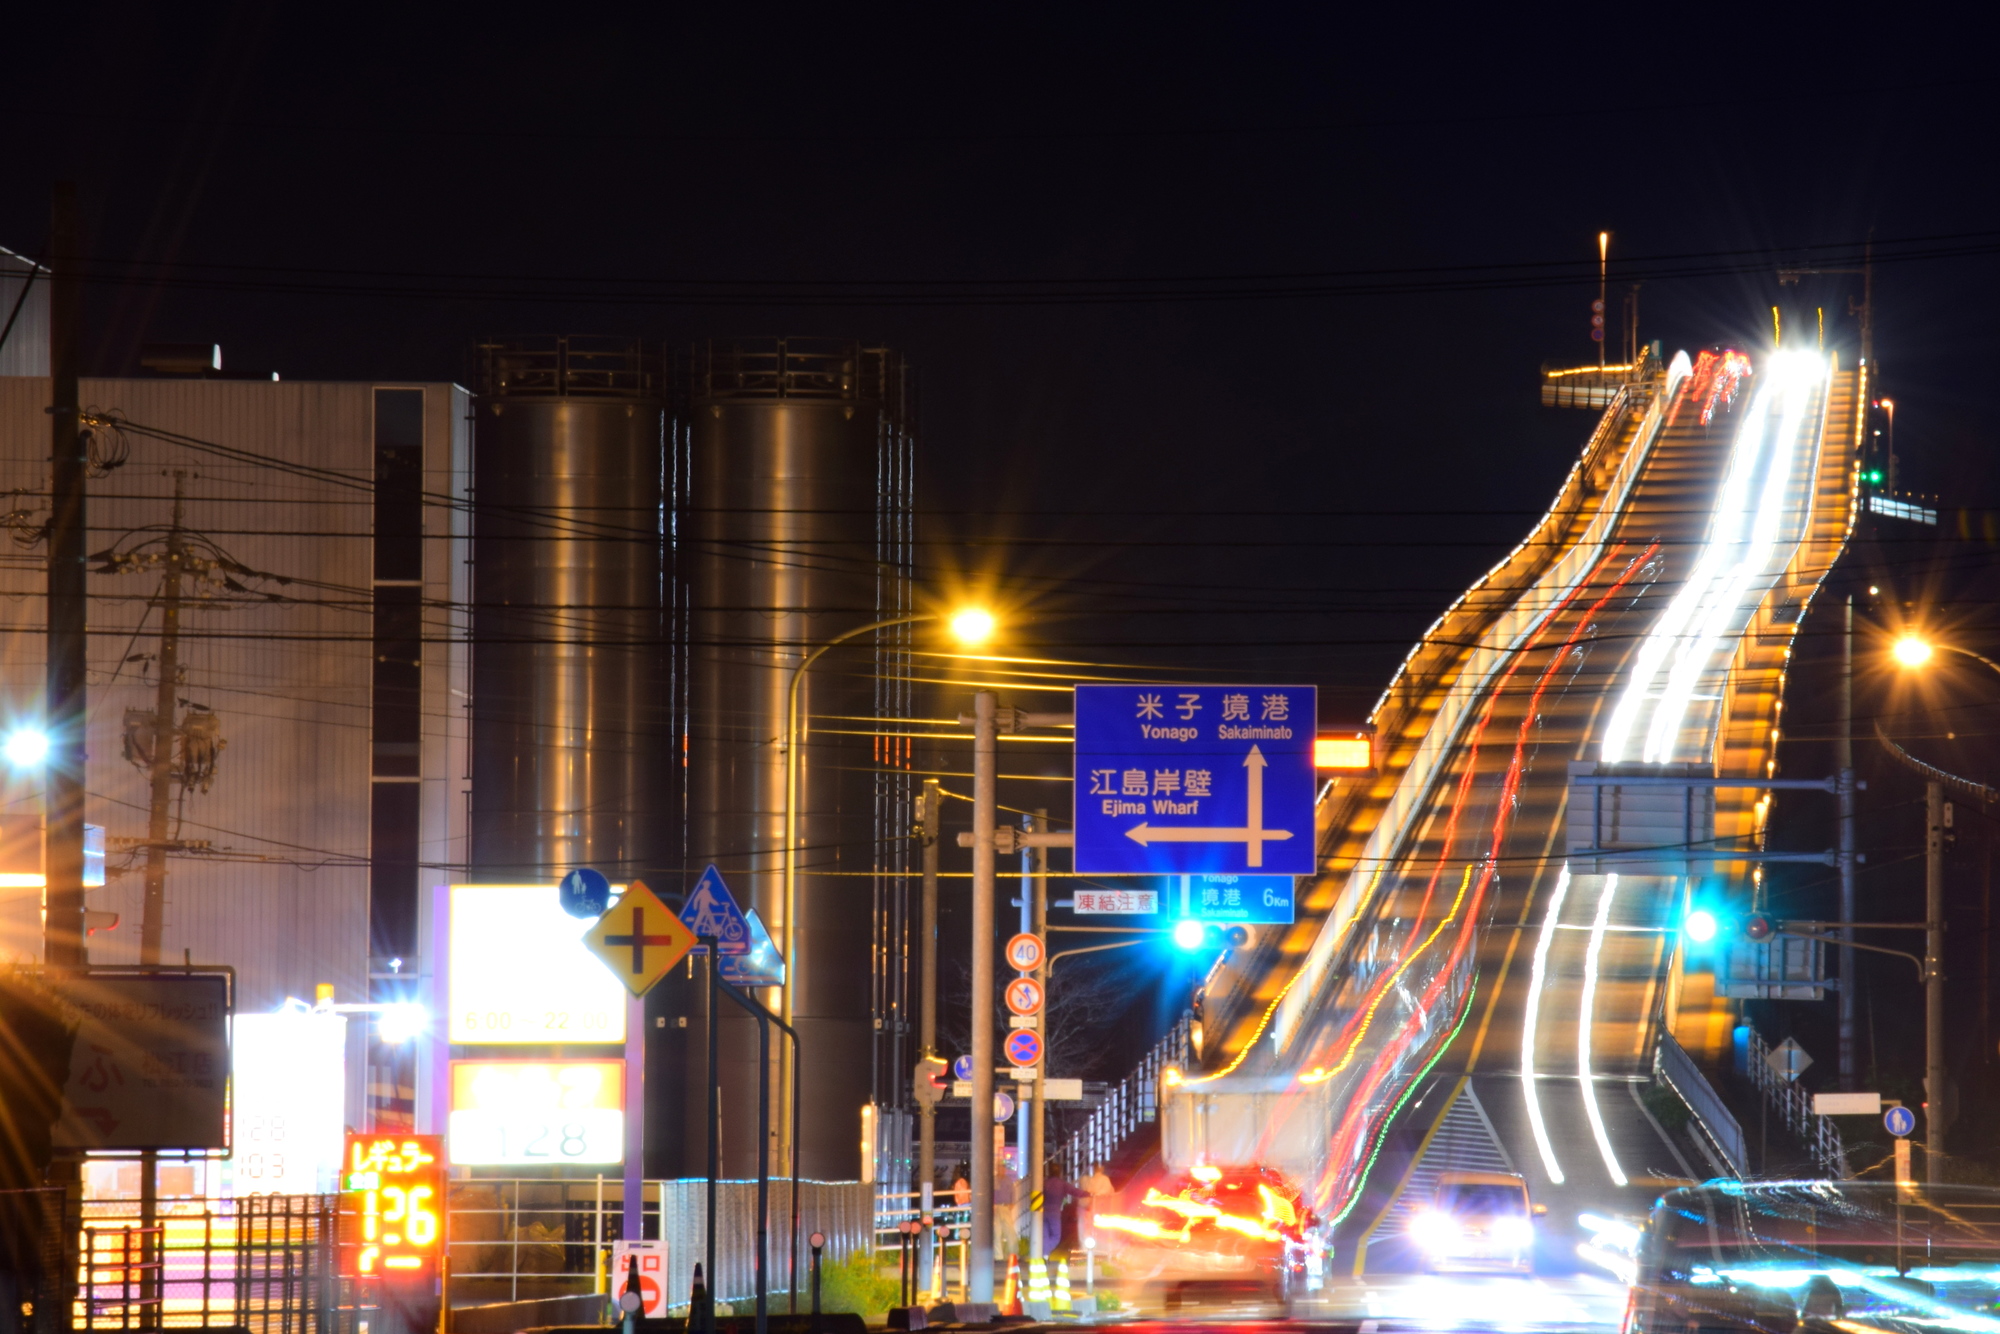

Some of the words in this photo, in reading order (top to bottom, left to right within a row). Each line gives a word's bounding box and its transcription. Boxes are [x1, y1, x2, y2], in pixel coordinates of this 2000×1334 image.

[1136, 693, 1203, 721] 米子
[1222, 693, 1290, 722] 境港
[1140, 724, 1199, 742] Yonago
[1218, 724, 1293, 741] Sakaiminato
[1089, 768, 1212, 798] 江島岸壁
[1102, 800, 1146, 817] Ejima
[1152, 799, 1199, 816] Wharf
[1202, 875, 1239, 885] Yonago
[1077, 893, 1155, 912] 凍結注意
[1201, 888, 1242, 907] 境港
[1201, 907, 1249, 918] Sakaiminato
[1016, 944, 1037, 961] 40
[543, 1011, 609, 1030] 2200
[496, 1121, 588, 1158] 128
[241, 1153, 285, 1179] 103
[352, 1140, 434, 1173] レギュラー
